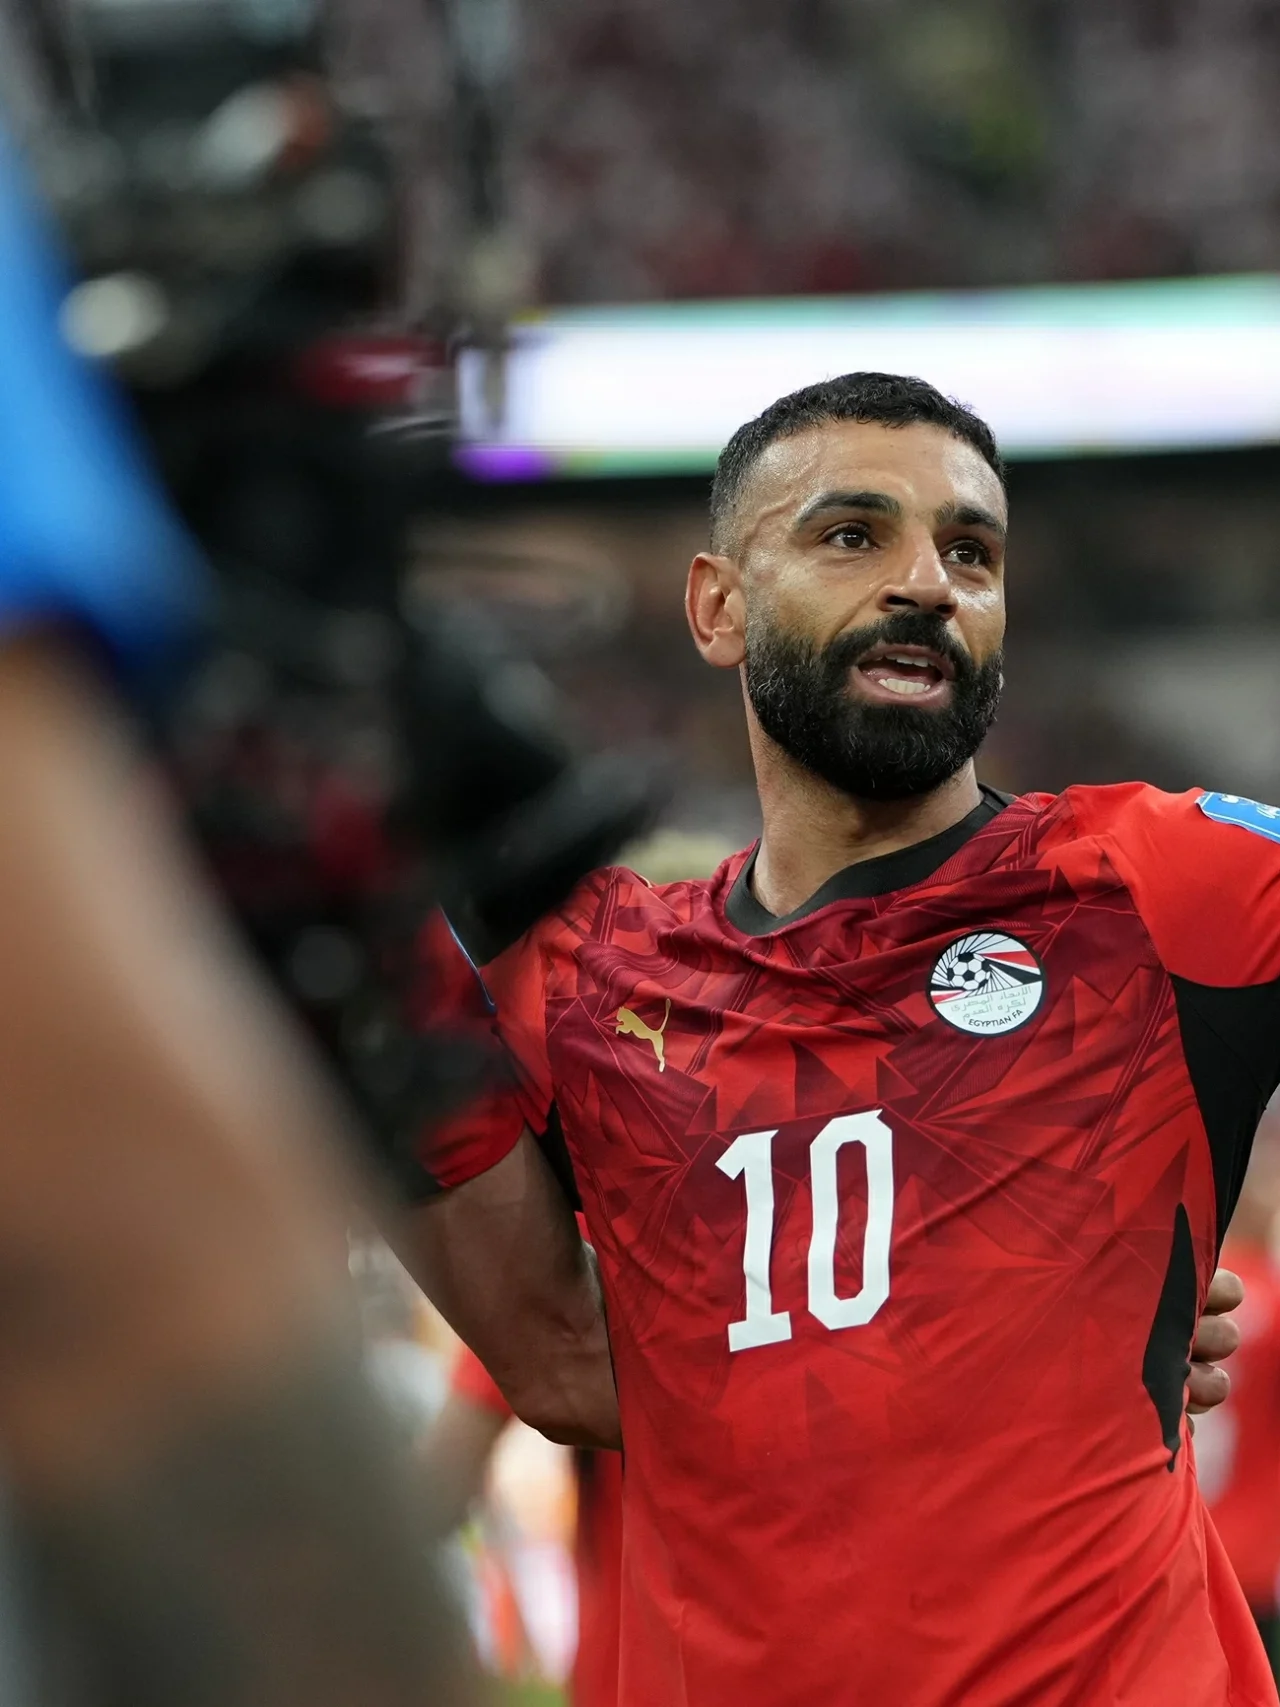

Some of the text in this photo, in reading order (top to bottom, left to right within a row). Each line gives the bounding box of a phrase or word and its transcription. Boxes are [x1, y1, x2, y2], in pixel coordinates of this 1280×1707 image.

[968, 1009, 1023, 1027] EGYPTIAN FA
[715, 1109, 894, 1353] 10
